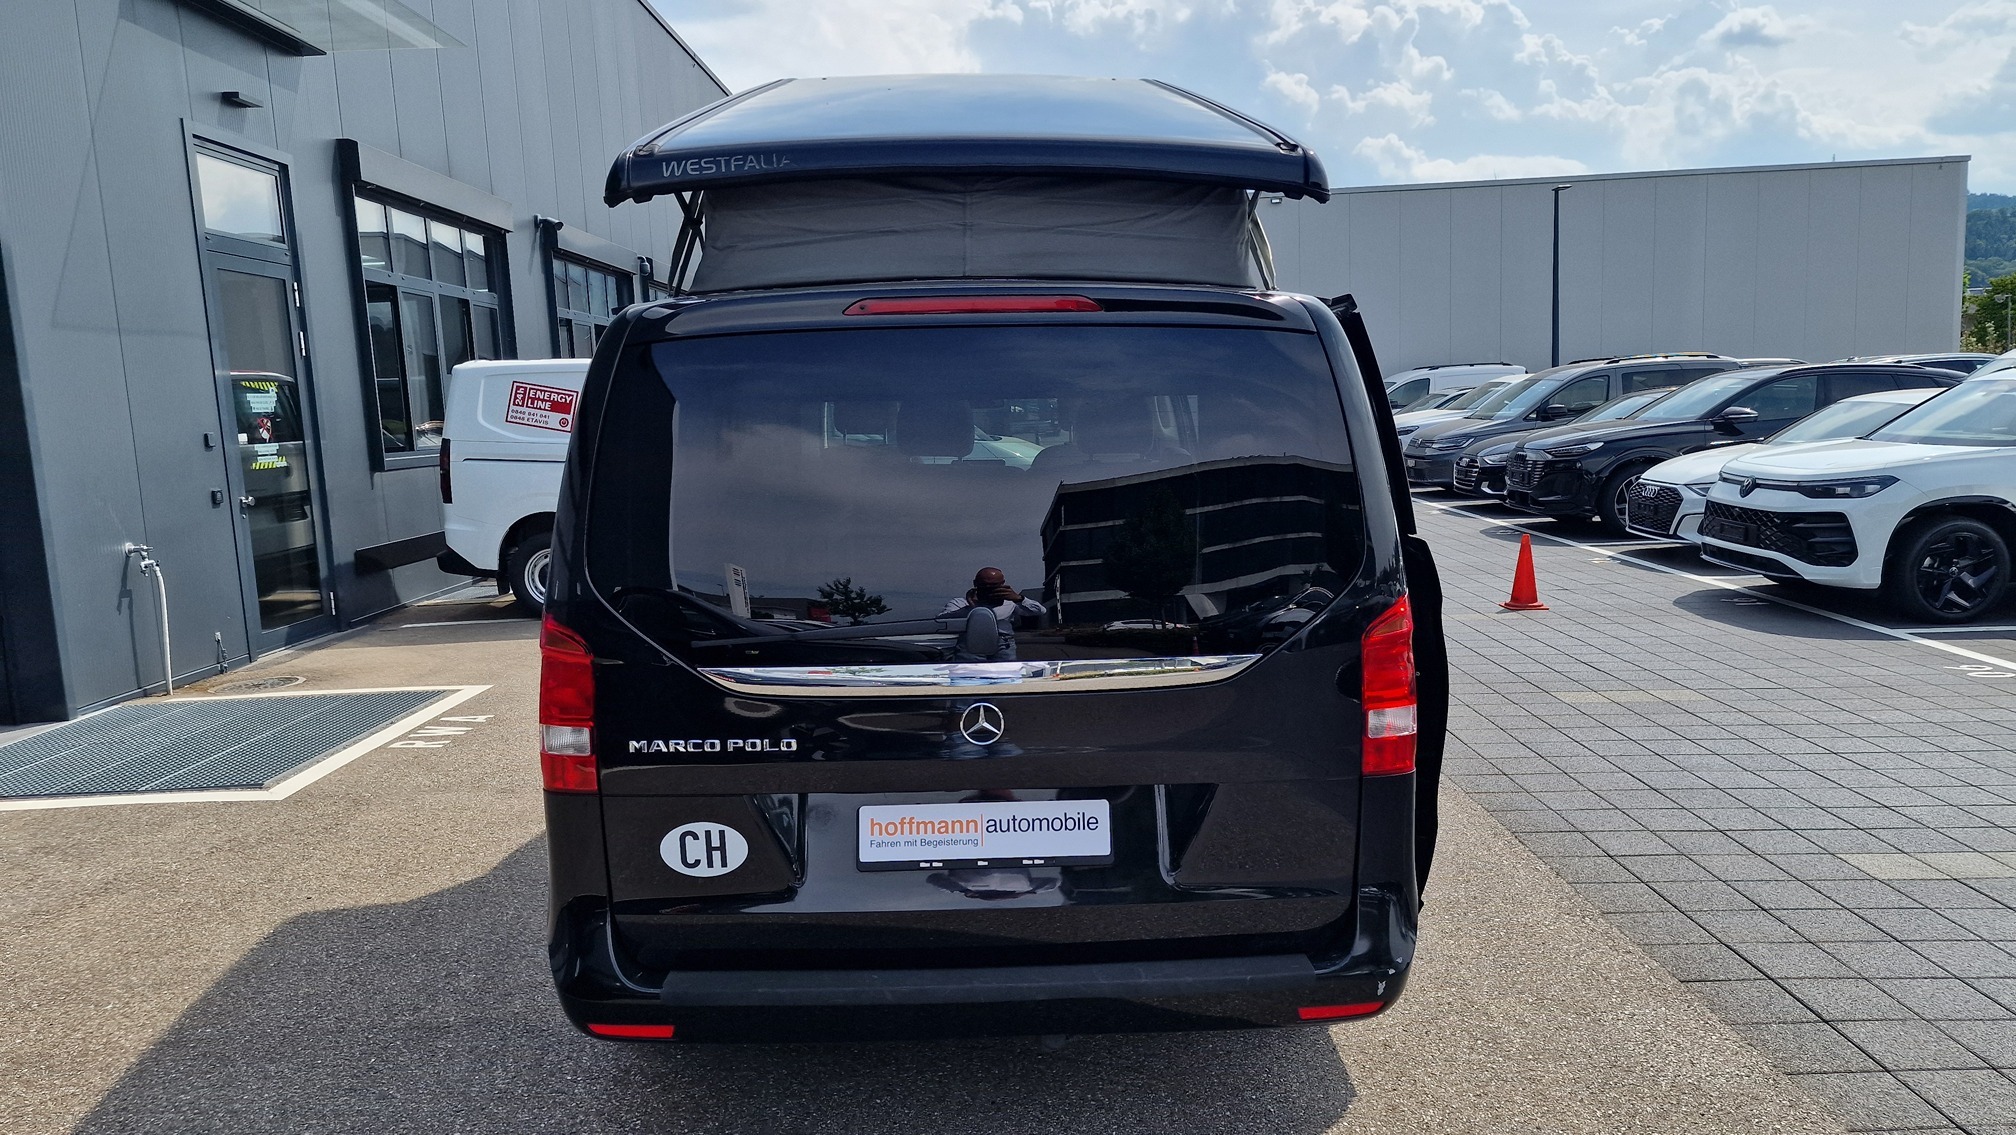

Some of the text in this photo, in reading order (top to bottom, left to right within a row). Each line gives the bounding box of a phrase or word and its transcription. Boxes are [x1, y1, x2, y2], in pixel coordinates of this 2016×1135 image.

[662, 153, 797, 178] WESTFALIA
[515, 388, 525, 405] 24h
[529, 389, 573, 404] ENERGY
[527, 399, 552, 411] LINE
[527, 417, 549, 425] ETAVIS
[628, 738, 798, 753] MARCO POLO
[869, 812, 1099, 837] hoffmann automobile
[678, 829, 728, 869] CH
[869, 836, 979, 849] Fahren mit Begeisterung
